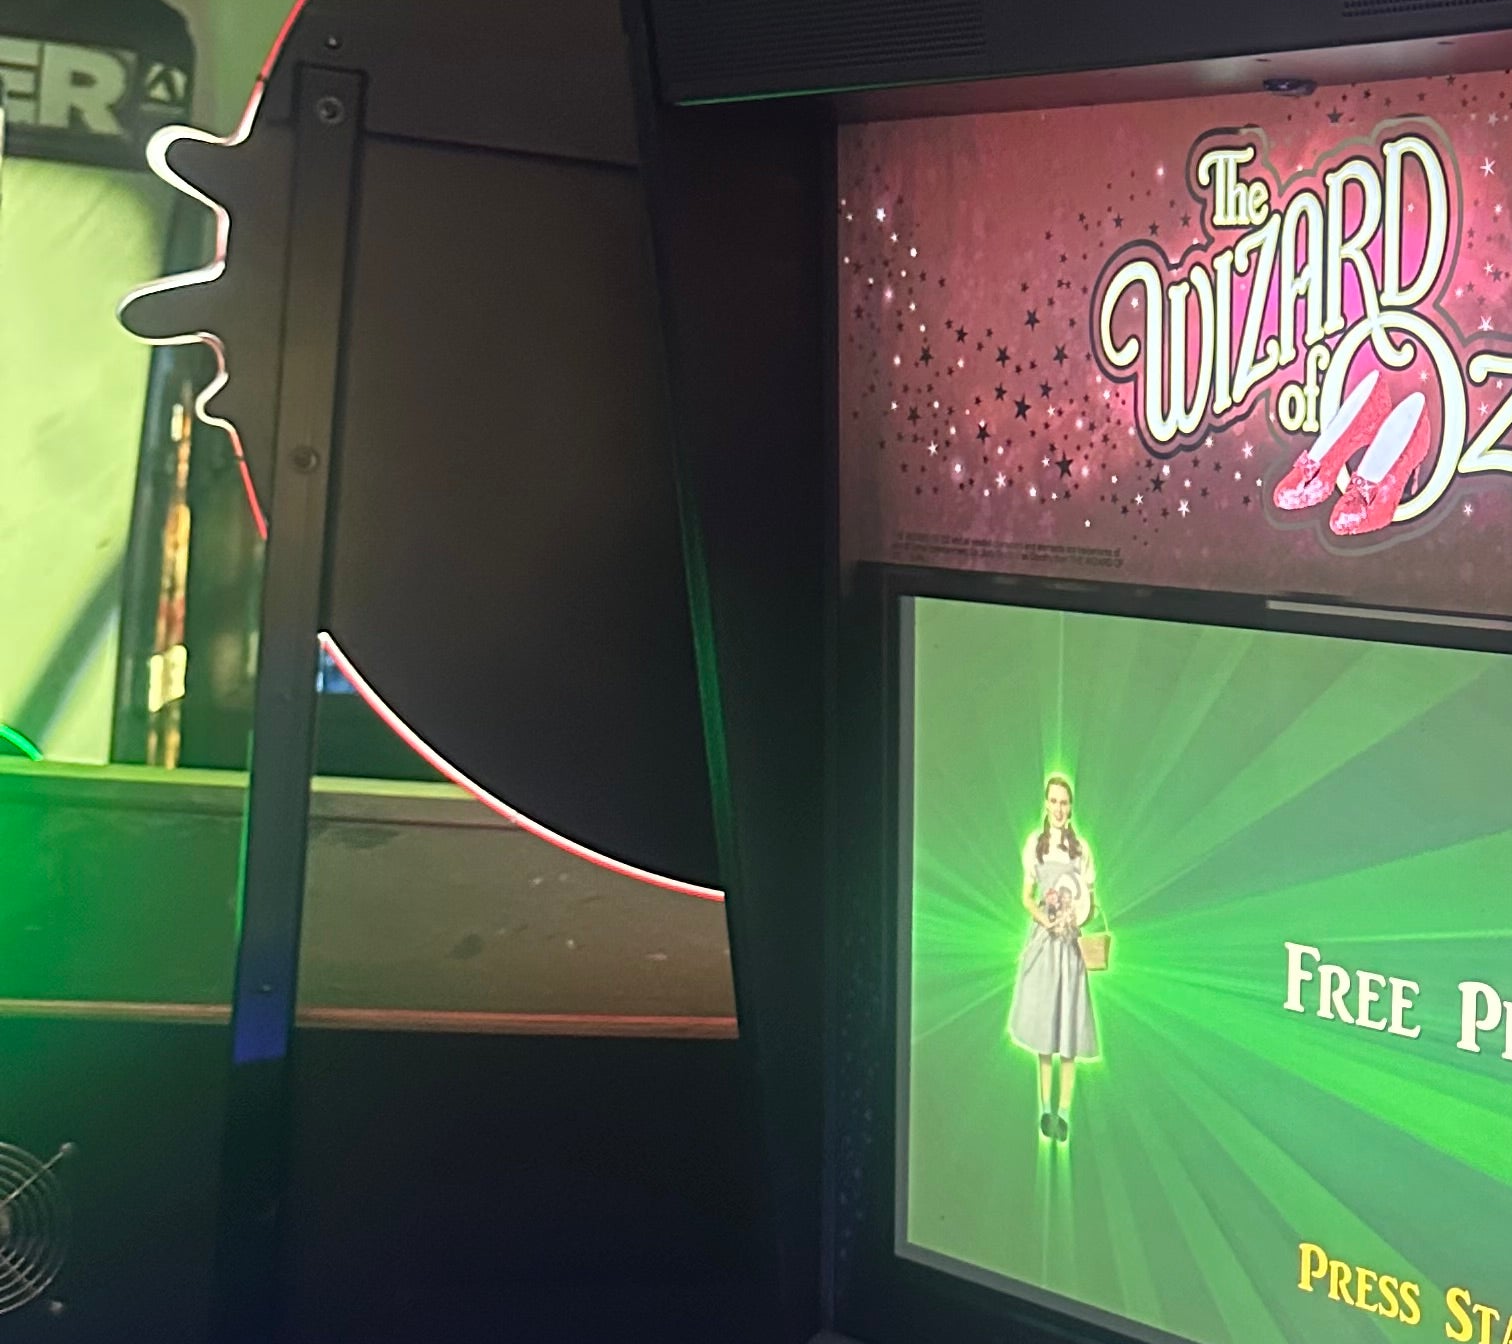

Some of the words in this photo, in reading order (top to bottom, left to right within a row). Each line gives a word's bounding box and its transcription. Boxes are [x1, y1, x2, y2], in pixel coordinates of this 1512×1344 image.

[1198, 145, 1270, 227] The
[1100, 136, 1447, 442] WIZARD
[1277, 343, 1332, 433] of
[1283, 941, 1422, 1040] FREE
[1297, 1242, 1421, 1325] PRESS
